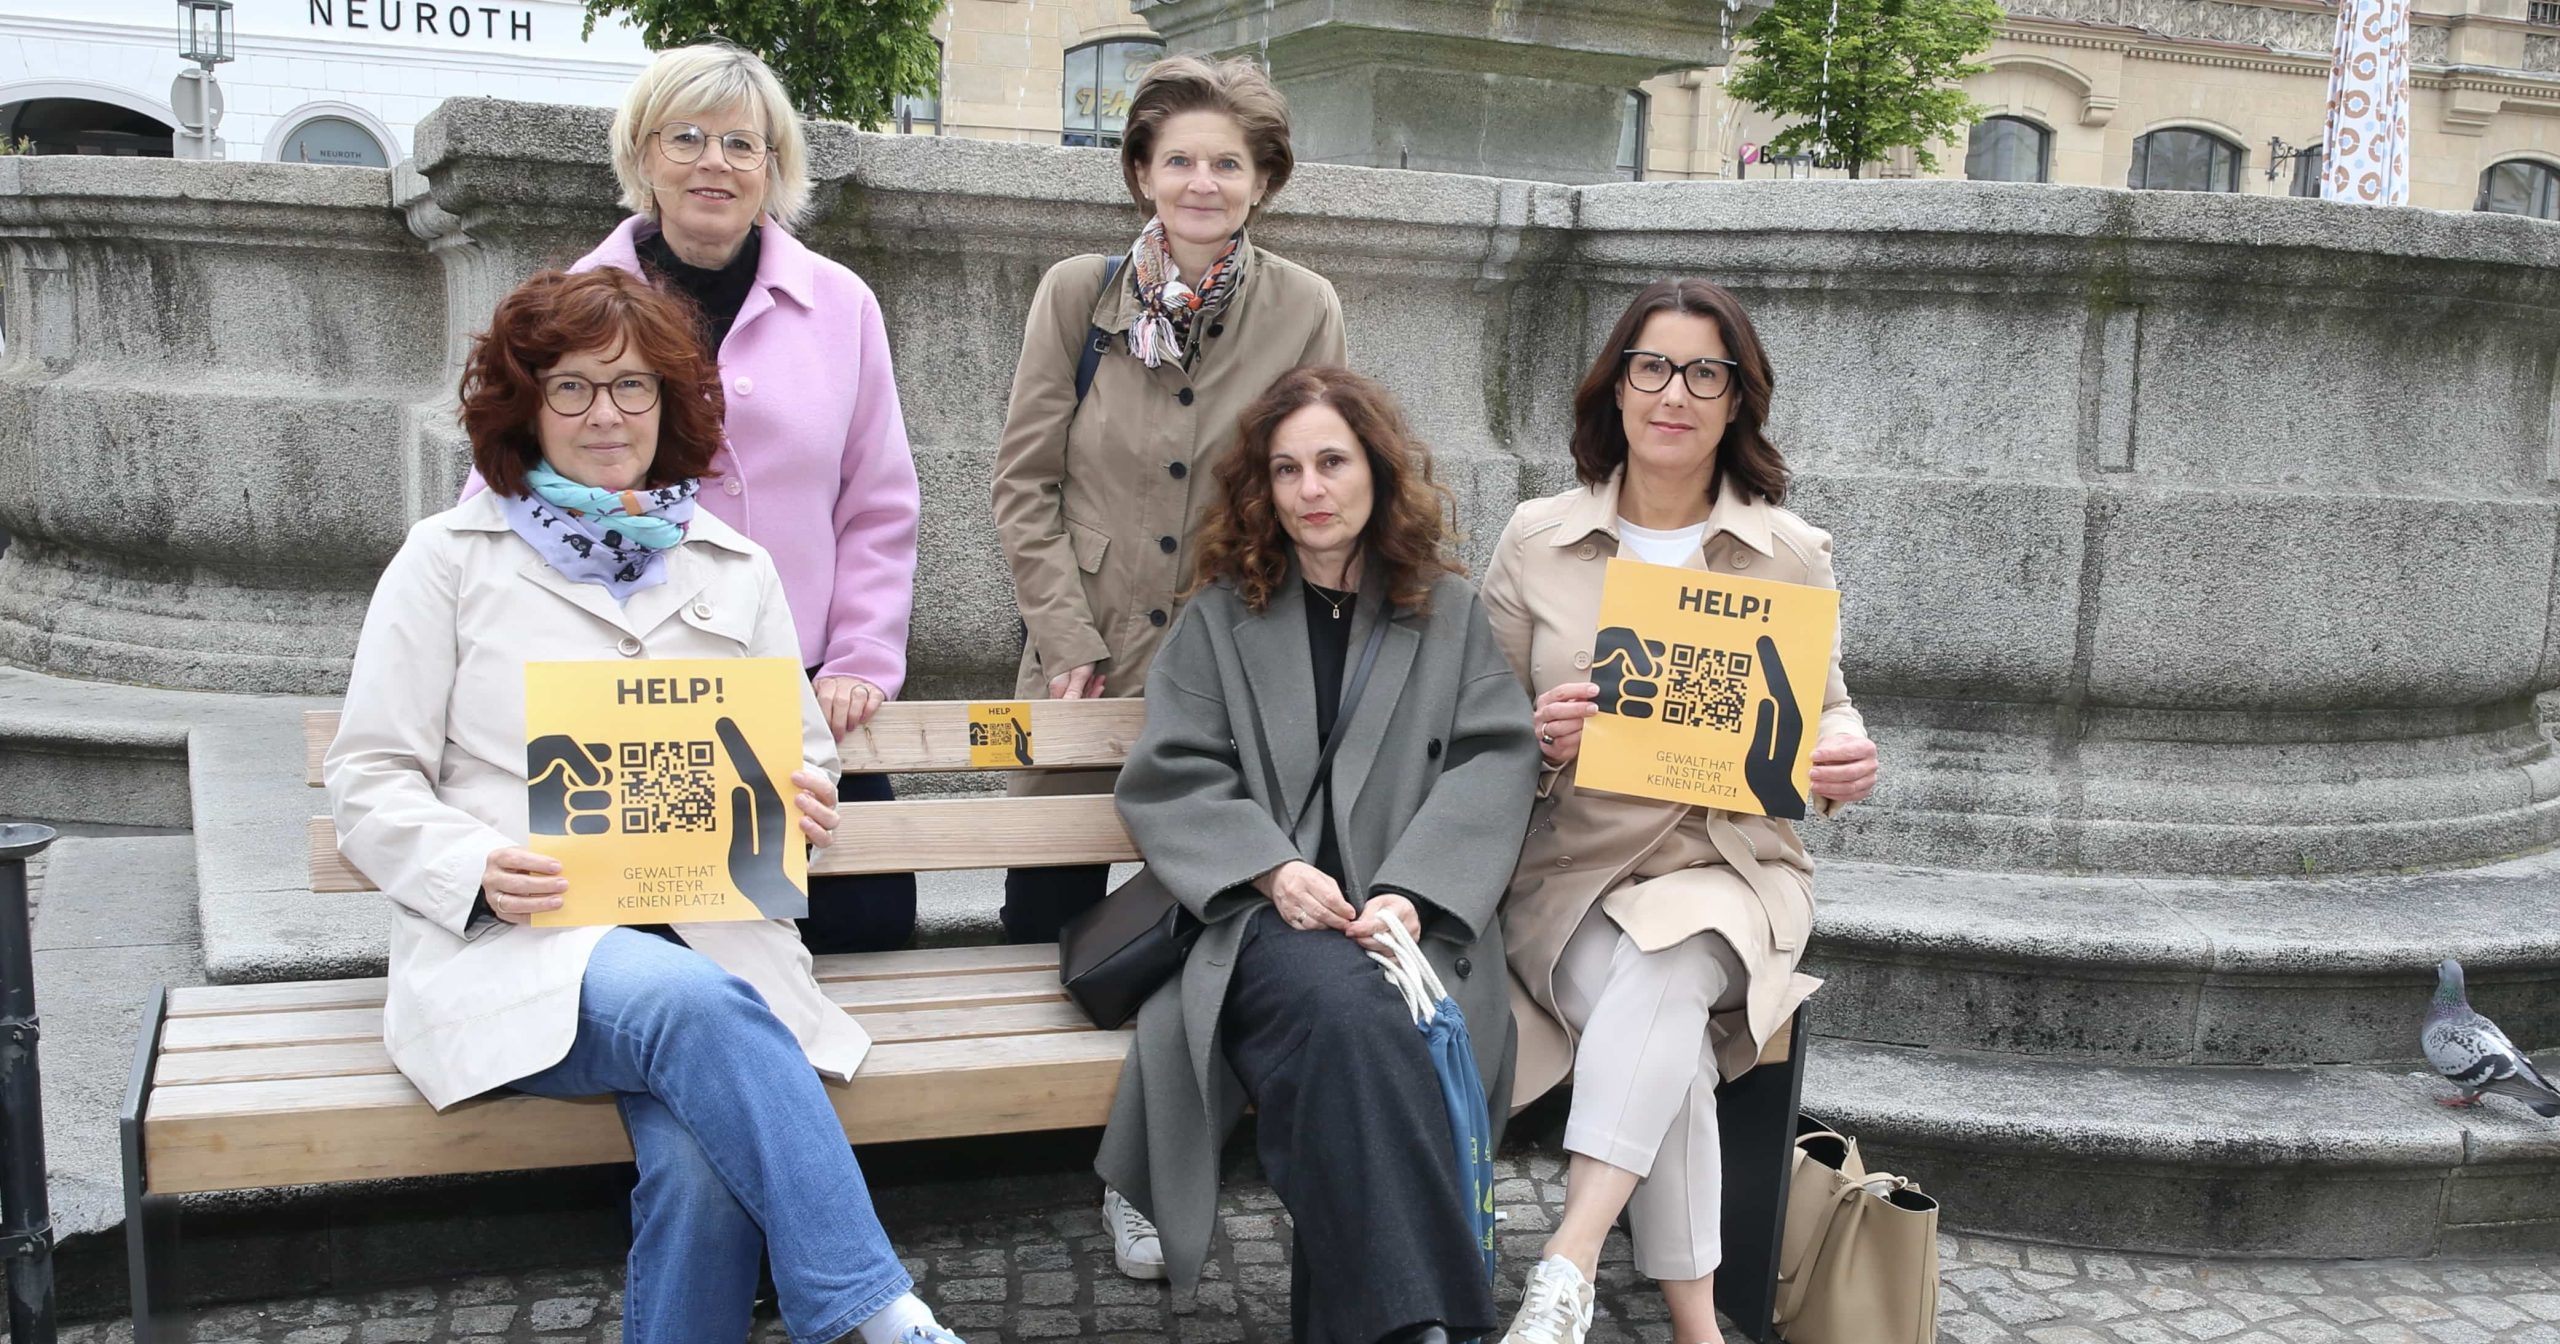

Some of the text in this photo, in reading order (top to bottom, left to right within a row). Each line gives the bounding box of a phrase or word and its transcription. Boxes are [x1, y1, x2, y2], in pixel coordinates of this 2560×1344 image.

[310, 0, 531, 42] NEUROTH
[320, 150, 361, 159] NEUROTH
[1679, 586, 1772, 623] HELP!
[617, 677, 724, 705] HELP!
[1656, 750, 1736, 772] GEWALT HAT
[1666, 764, 1722, 783] IN STEYR
[1646, 773, 1737, 798] KEINEN PLATZ!
[623, 865, 717, 880] GEWALT HAT
[638, 879, 704, 893] IN STEYR
[617, 893, 725, 909] KEINEN PLATZ!
